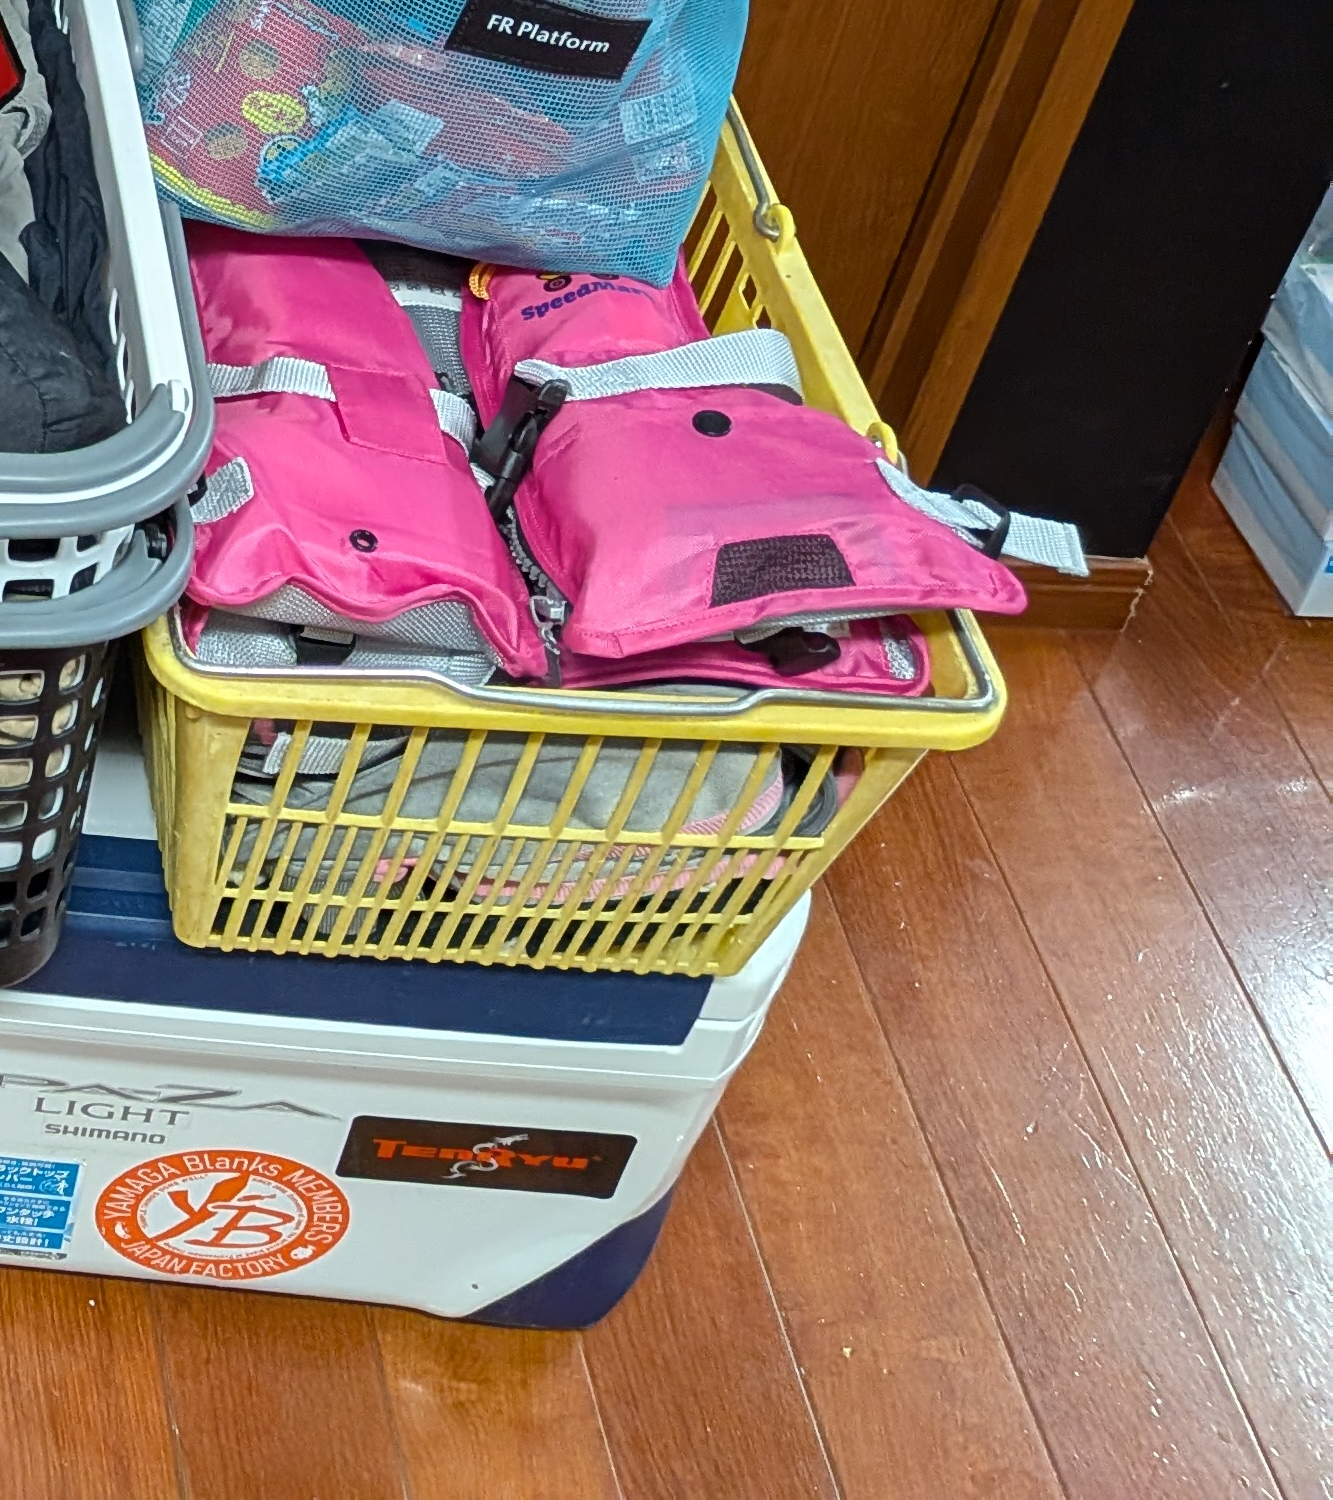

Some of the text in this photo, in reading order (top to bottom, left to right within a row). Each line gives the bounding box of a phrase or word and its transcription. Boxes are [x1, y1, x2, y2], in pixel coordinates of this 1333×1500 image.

[486, 13, 610, 53] FR Platform
[34, 1097, 190, 1127] LIGHT
[44, 1122, 166, 1145] SHIMANO
[103, 1160, 181, 1220] YAMAGA
[182, 1152, 283, 1177] Blanks
[283, 1168, 344, 1245] MEMBERS
[120, 1240, 190, 1273] JAPAN
[189, 1252, 290, 1279] FACTORY
